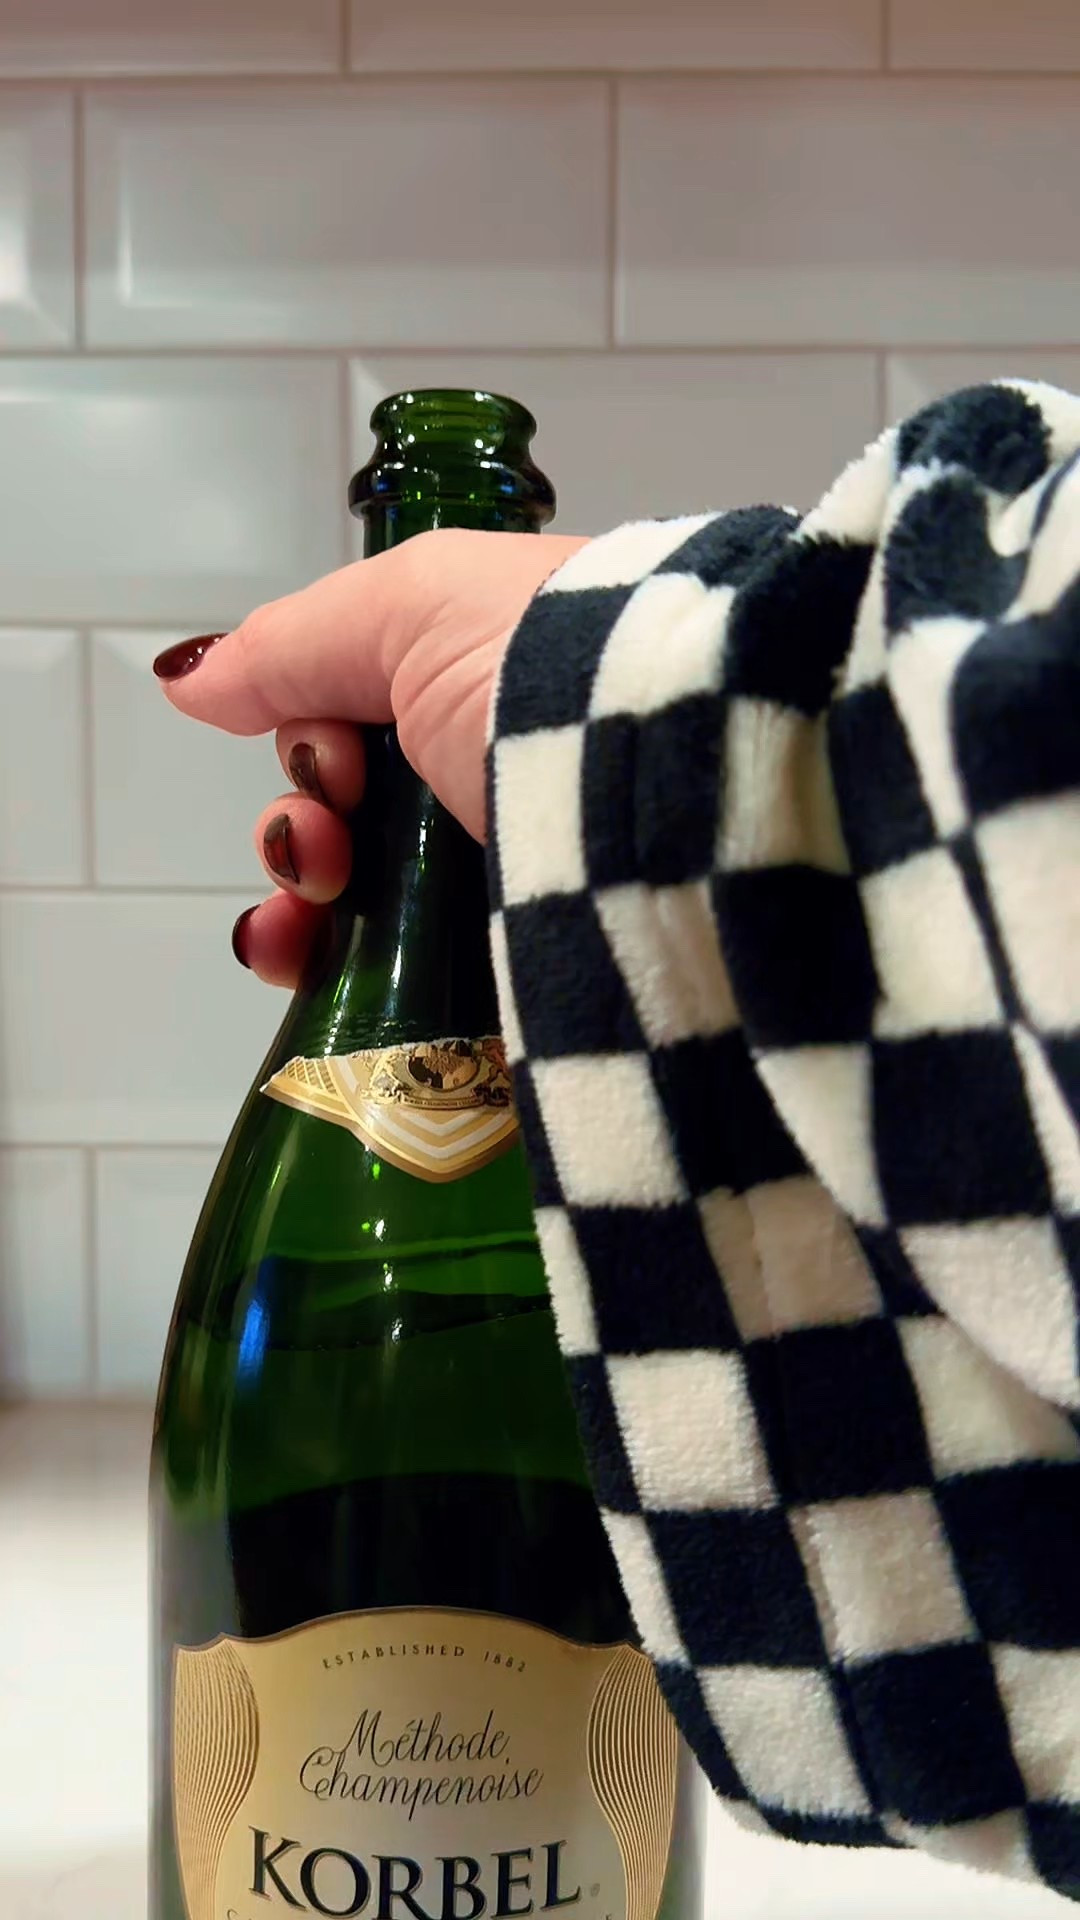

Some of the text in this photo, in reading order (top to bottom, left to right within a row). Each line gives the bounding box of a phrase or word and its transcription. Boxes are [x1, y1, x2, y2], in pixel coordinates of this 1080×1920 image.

[322, 1644, 526, 1673] ESTABLISHED 1882
[344, 1708, 510, 1768] Méthode
[299, 1746, 545, 1822] Champenoise
[248, 1825, 582, 1920] KORBEL
